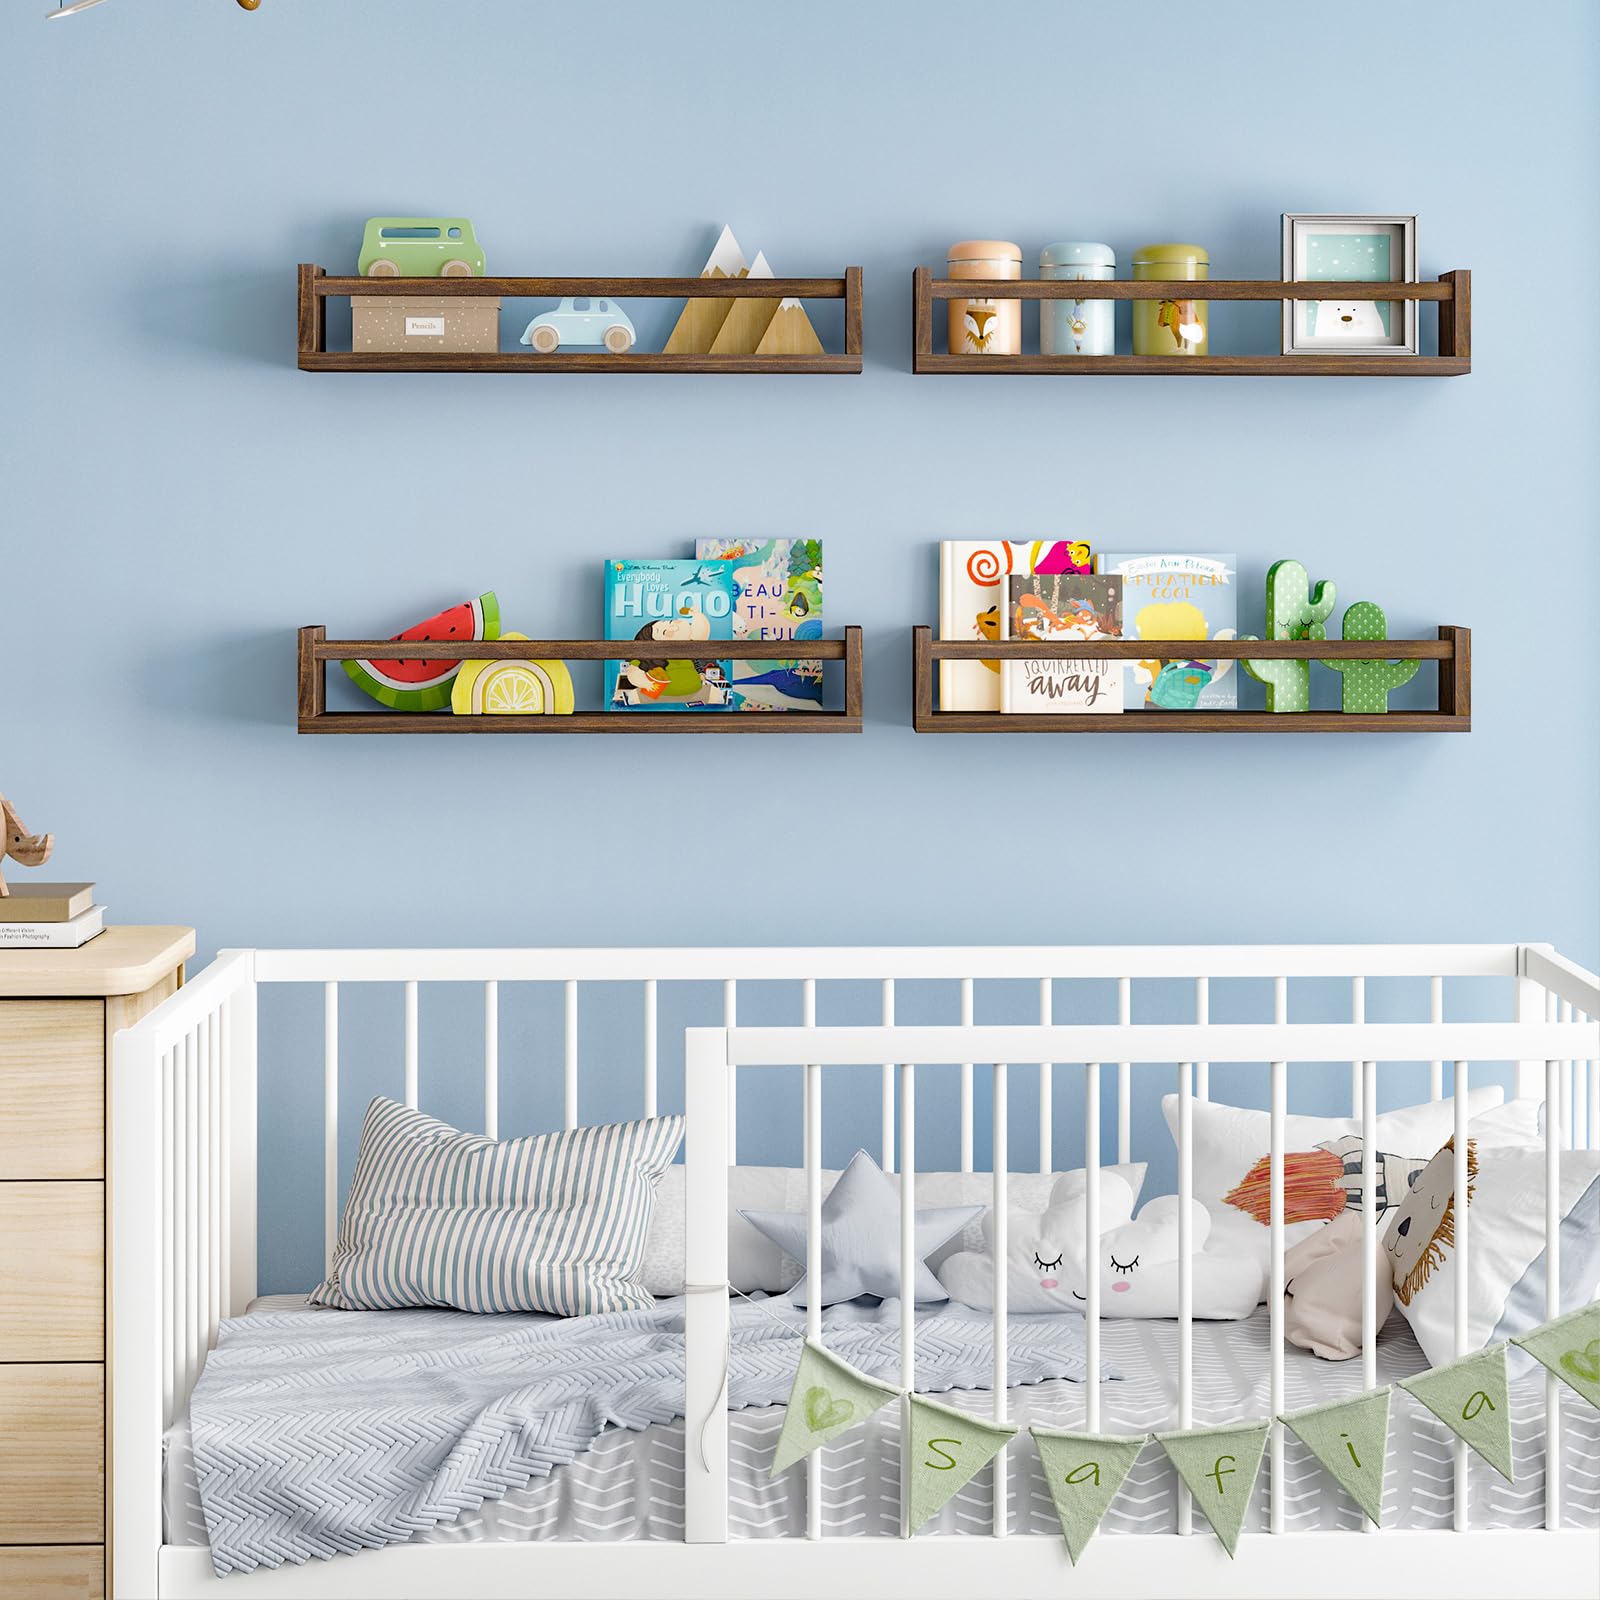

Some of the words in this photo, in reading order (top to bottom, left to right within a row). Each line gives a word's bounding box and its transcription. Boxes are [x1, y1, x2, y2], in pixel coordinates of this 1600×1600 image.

[617, 572, 661, 584] Everybody
[646, 583, 670, 592] Loves
[1151, 587, 1193, 599] COOL
[615, 583, 731, 618] Hugo
[747, 605, 776, 619] TI-
[760, 627, 795, 641] FUL
[1027, 674, 1107, 707] away
[1064, 1462, 1100, 1487] a
[1205, 1455, 1236, 1495] f
[1340, 1433, 1362, 1468] i
[1461, 1391, 1496, 1421] a
